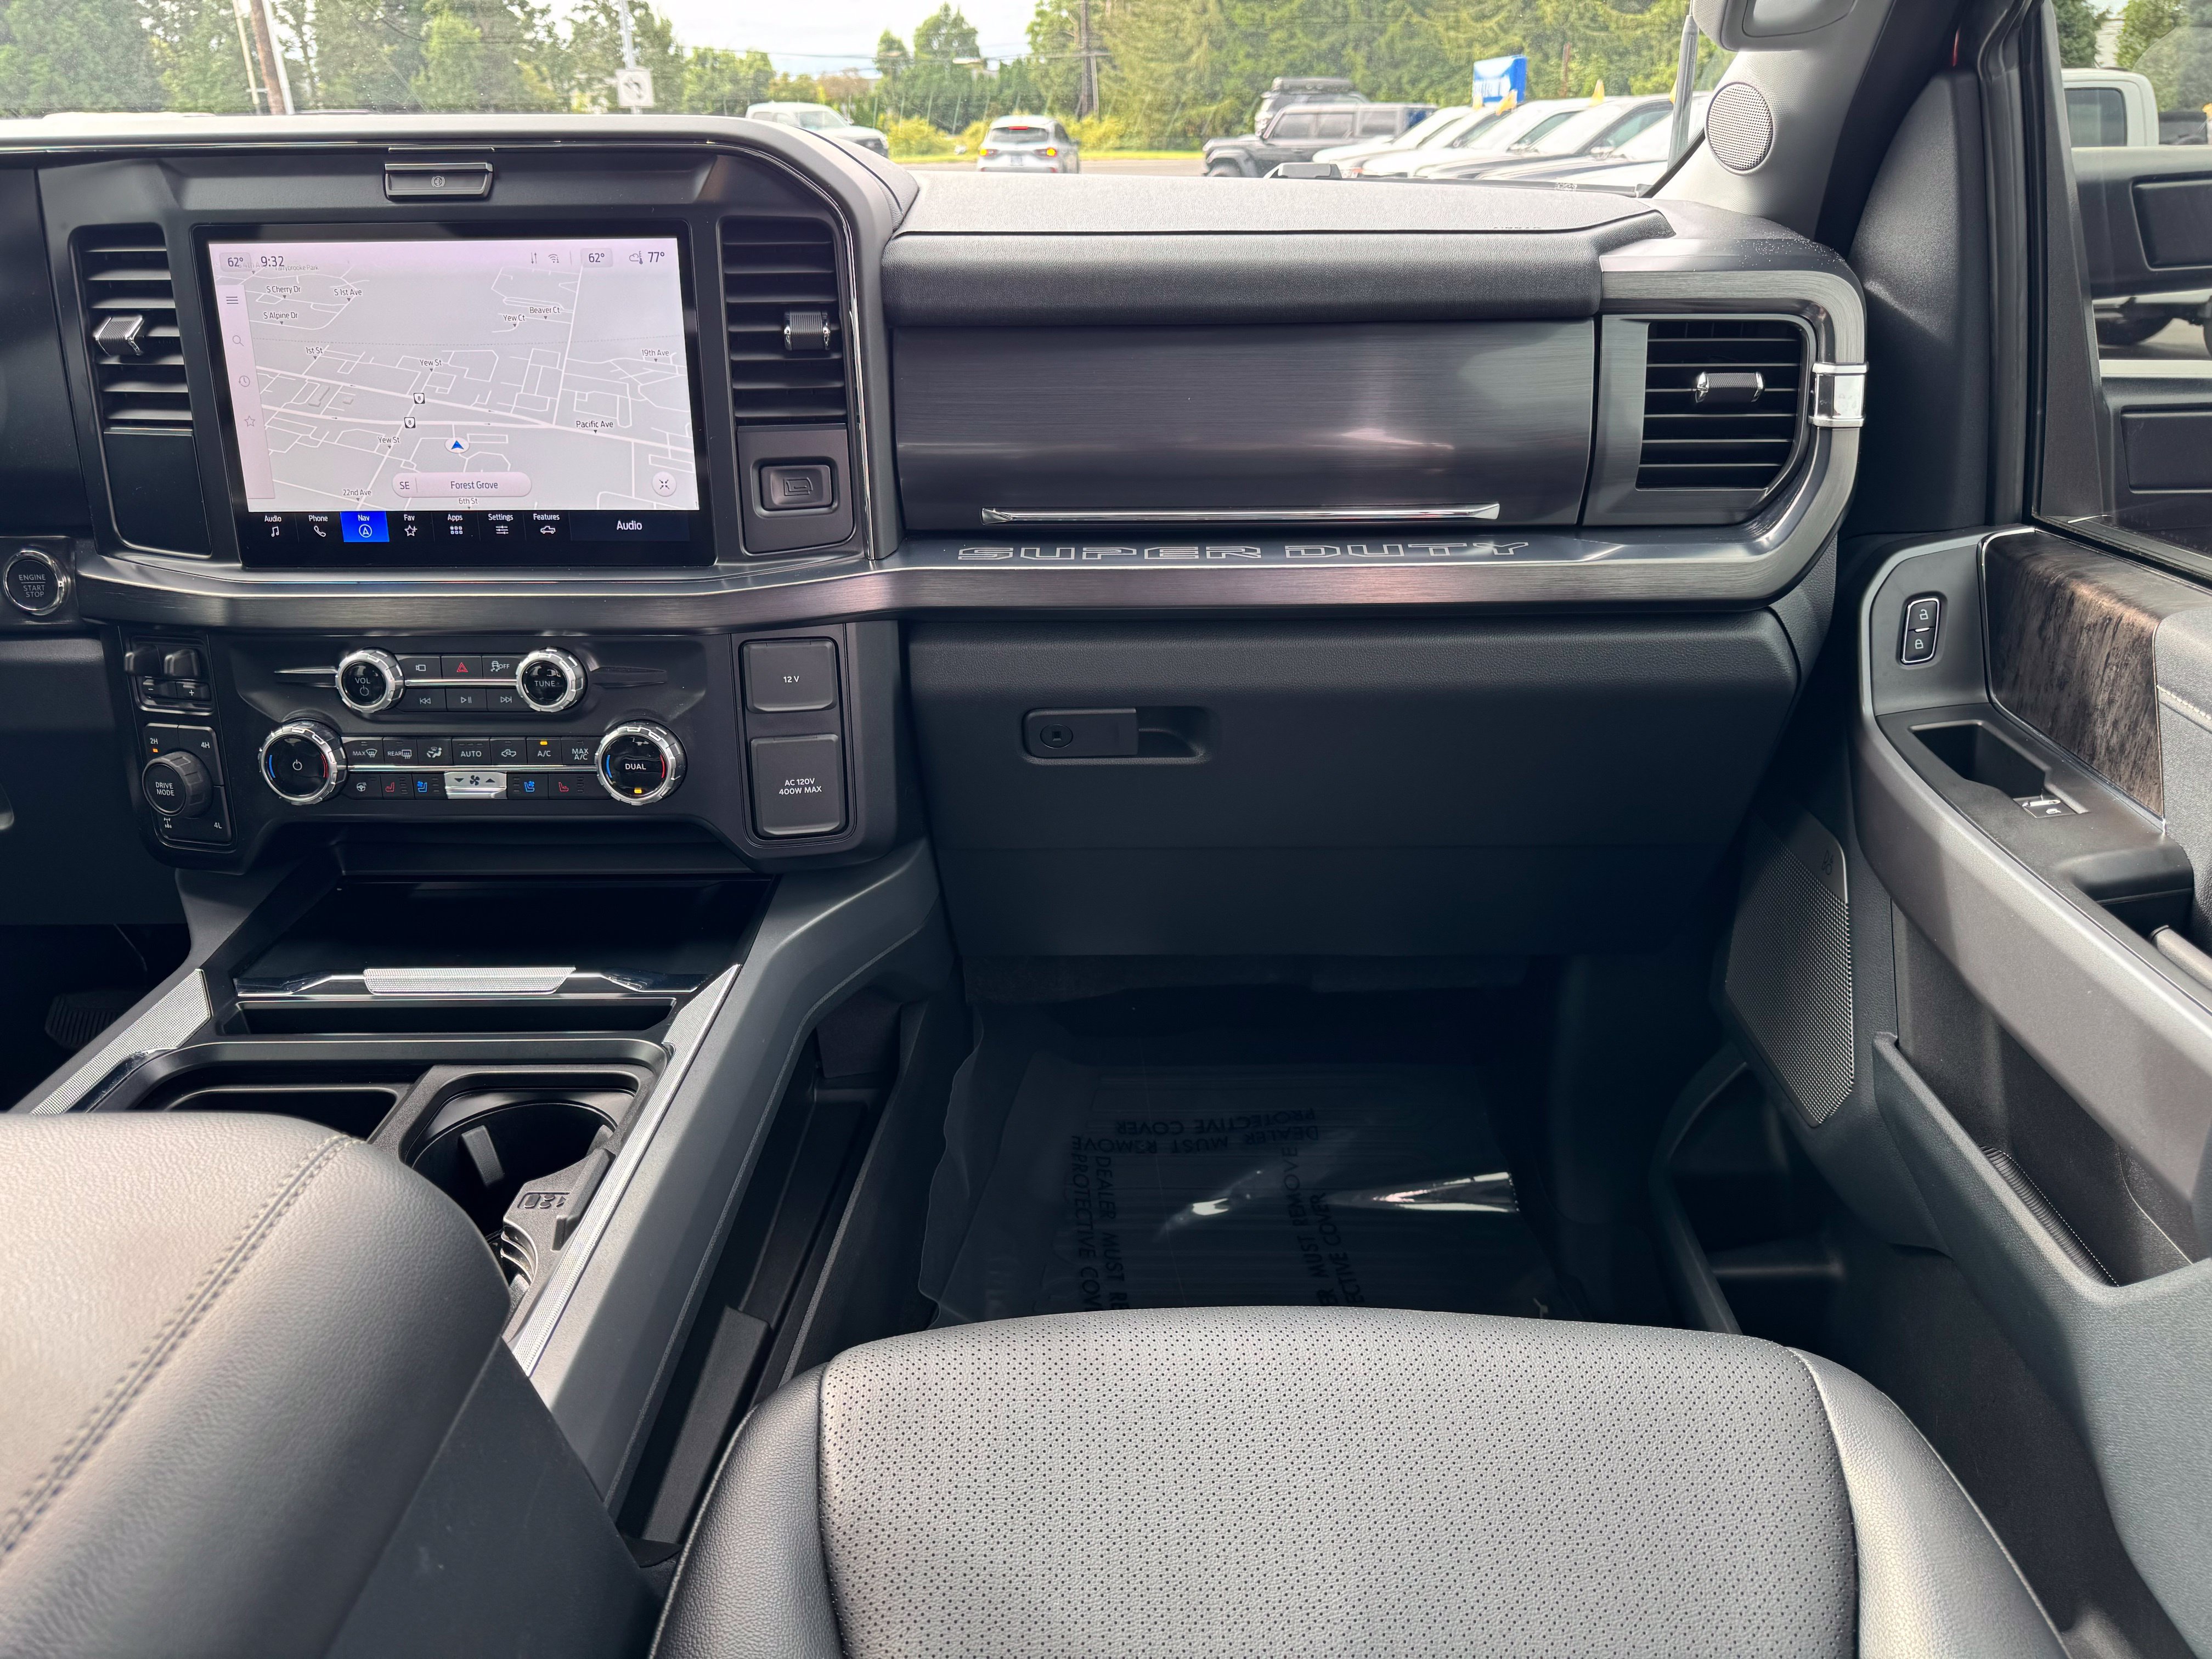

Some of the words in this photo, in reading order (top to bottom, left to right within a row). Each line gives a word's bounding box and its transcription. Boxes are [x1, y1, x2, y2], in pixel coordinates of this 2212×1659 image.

[227, 257, 244, 267] 62°
[261, 256, 285, 267] 9:32
[588, 253, 605, 263] 62°
[648, 251, 665, 263] 77°
[272, 285, 291, 295] Cherry
[269, 312, 289, 321] Alpine
[447, 514, 462, 522] Apps
[488, 514, 514, 522] Settings
[617, 521, 642, 531] Audio
[958, 546, 1262, 561] SUPER
[1284, 542, 1529, 558] DUTY
[155, 781, 173, 789] DRIVE
[156, 788, 174, 796] MODE
[804, 786, 822, 794] MAX
[1115, 1119, 1184, 1136] COVER
[1193, 1108, 1316, 1134] PROTECTIVE
[1244, 1125, 1318, 1146] DEALER
[1071, 1134, 1158, 1154] REMOVE
[1171, 1135, 1228, 1154] MUST
[1095, 1155, 1117, 1221] DEALER
[1281, 1147, 1308, 1227] REMOVE
[1071, 1153, 1097, 1259] PROTECTIVE
[1309, 1192, 1341, 1246] COVER
[1101, 1232, 1125, 1282] MUST
[1296, 1235, 1329, 1278] MUST
